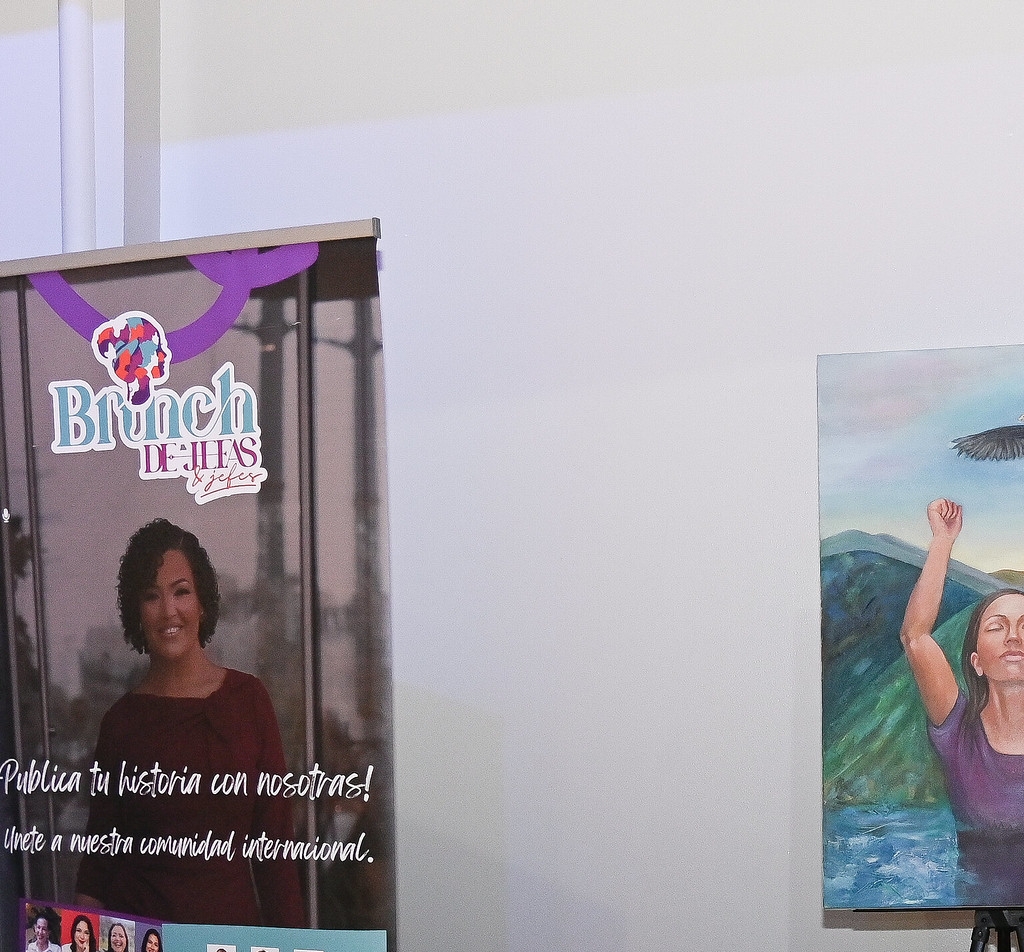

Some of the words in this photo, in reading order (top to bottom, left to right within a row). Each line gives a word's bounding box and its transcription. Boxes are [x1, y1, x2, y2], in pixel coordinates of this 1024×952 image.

[54, 367, 256, 448] Brunch
[143, 443, 177, 474] DE
[192, 464, 203, 487] &
[205, 463, 263, 492] jefes
[0, 758, 81, 795] Publica
[90, 760, 109, 797] tu
[118, 760, 202, 798] historia
[210, 769, 248, 797] con
[257, 763, 374, 802] nosotras!
[51, 835, 62, 852] a
[70, 827, 134, 856] nuestra
[140, 830, 236, 859] comunidad
[243, 831, 375, 864] internacional.
